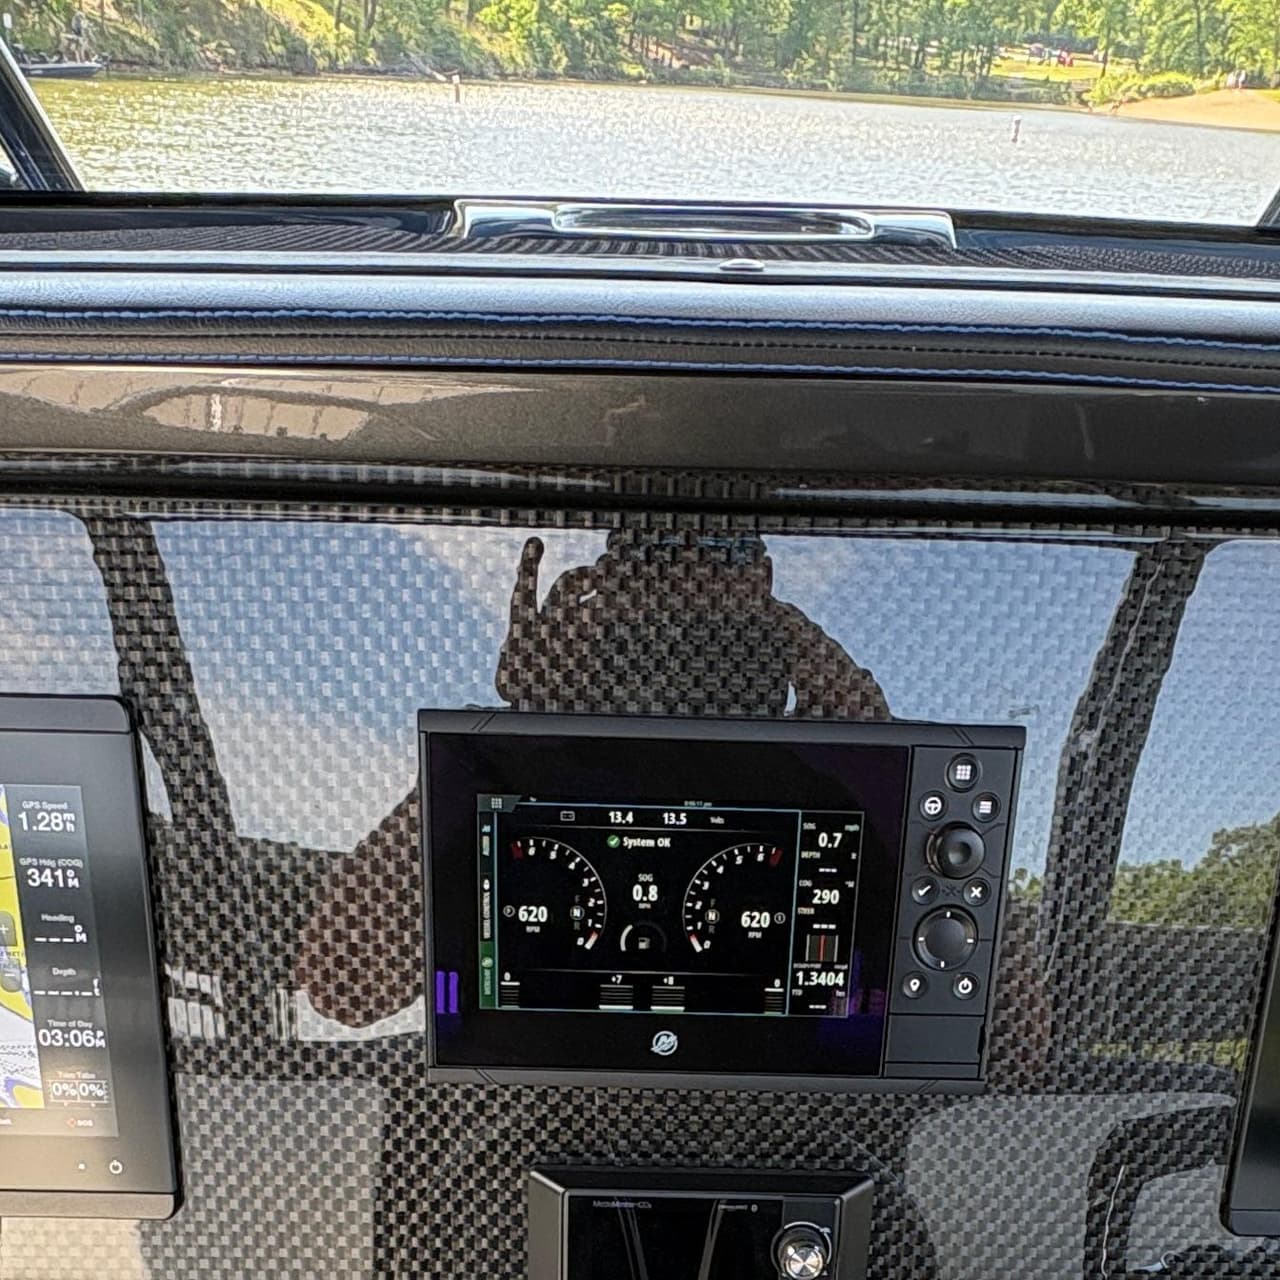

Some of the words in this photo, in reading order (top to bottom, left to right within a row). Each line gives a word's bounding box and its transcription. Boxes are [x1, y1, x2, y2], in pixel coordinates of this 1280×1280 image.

[22, 801, 41, 809] GPS
[19, 812, 63, 831] 1.28
[609, 811, 633, 824] 13.4
[663, 812, 687, 825] 13.5
[623, 837, 655, 849] System
[657, 838, 672, 848] OK
[818, 832, 842, 848] 0.7
[20, 858, 37, 866] GPS
[27, 868, 64, 887] 341
[638, 873, 653, 882] SOG
[632, 884, 658, 901] 0.8
[812, 889, 840, 904] 290
[518, 905, 548, 922] 620
[741, 911, 771, 928] 620
[796, 971, 844, 986] 1.3404
[38, 1029, 95, 1047] 03:06
[52, 1083, 77, 1096] 0%
[79, 1083, 104, 1096] 0%
